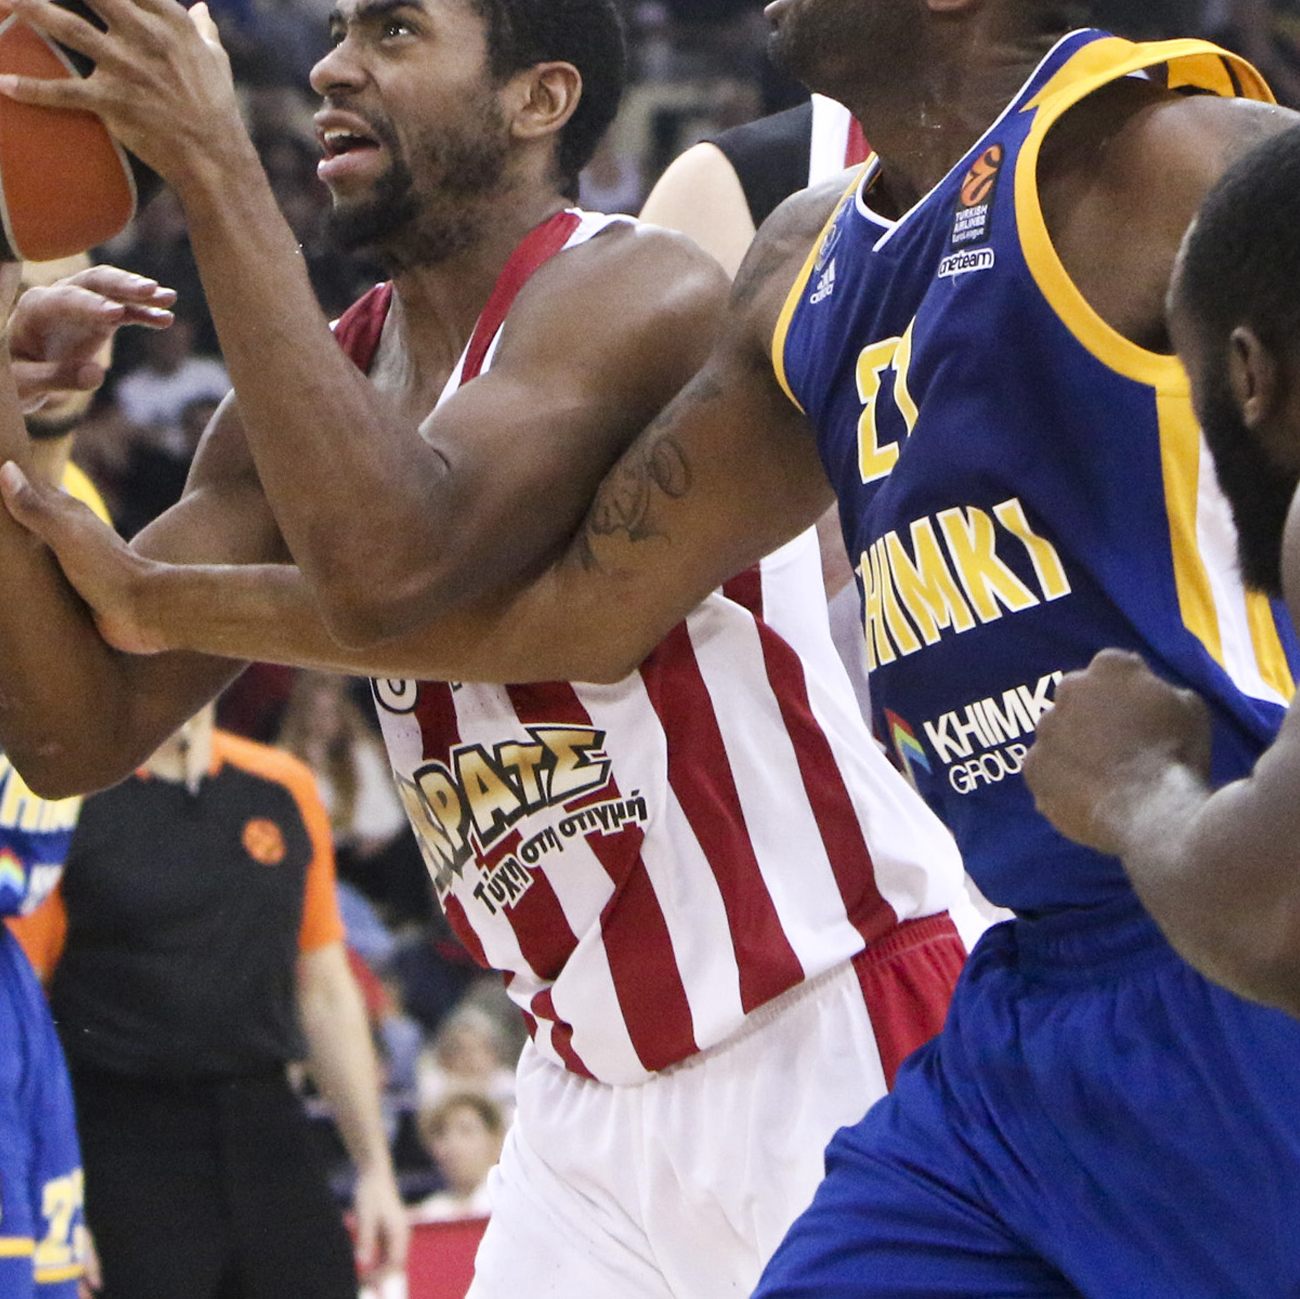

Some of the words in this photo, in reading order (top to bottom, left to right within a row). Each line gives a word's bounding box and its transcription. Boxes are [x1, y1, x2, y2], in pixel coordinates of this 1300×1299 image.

[854, 498, 1071, 673] HIMKI
[949, 743, 1028, 794] GROUP
[520, 825, 564, 864] στη
